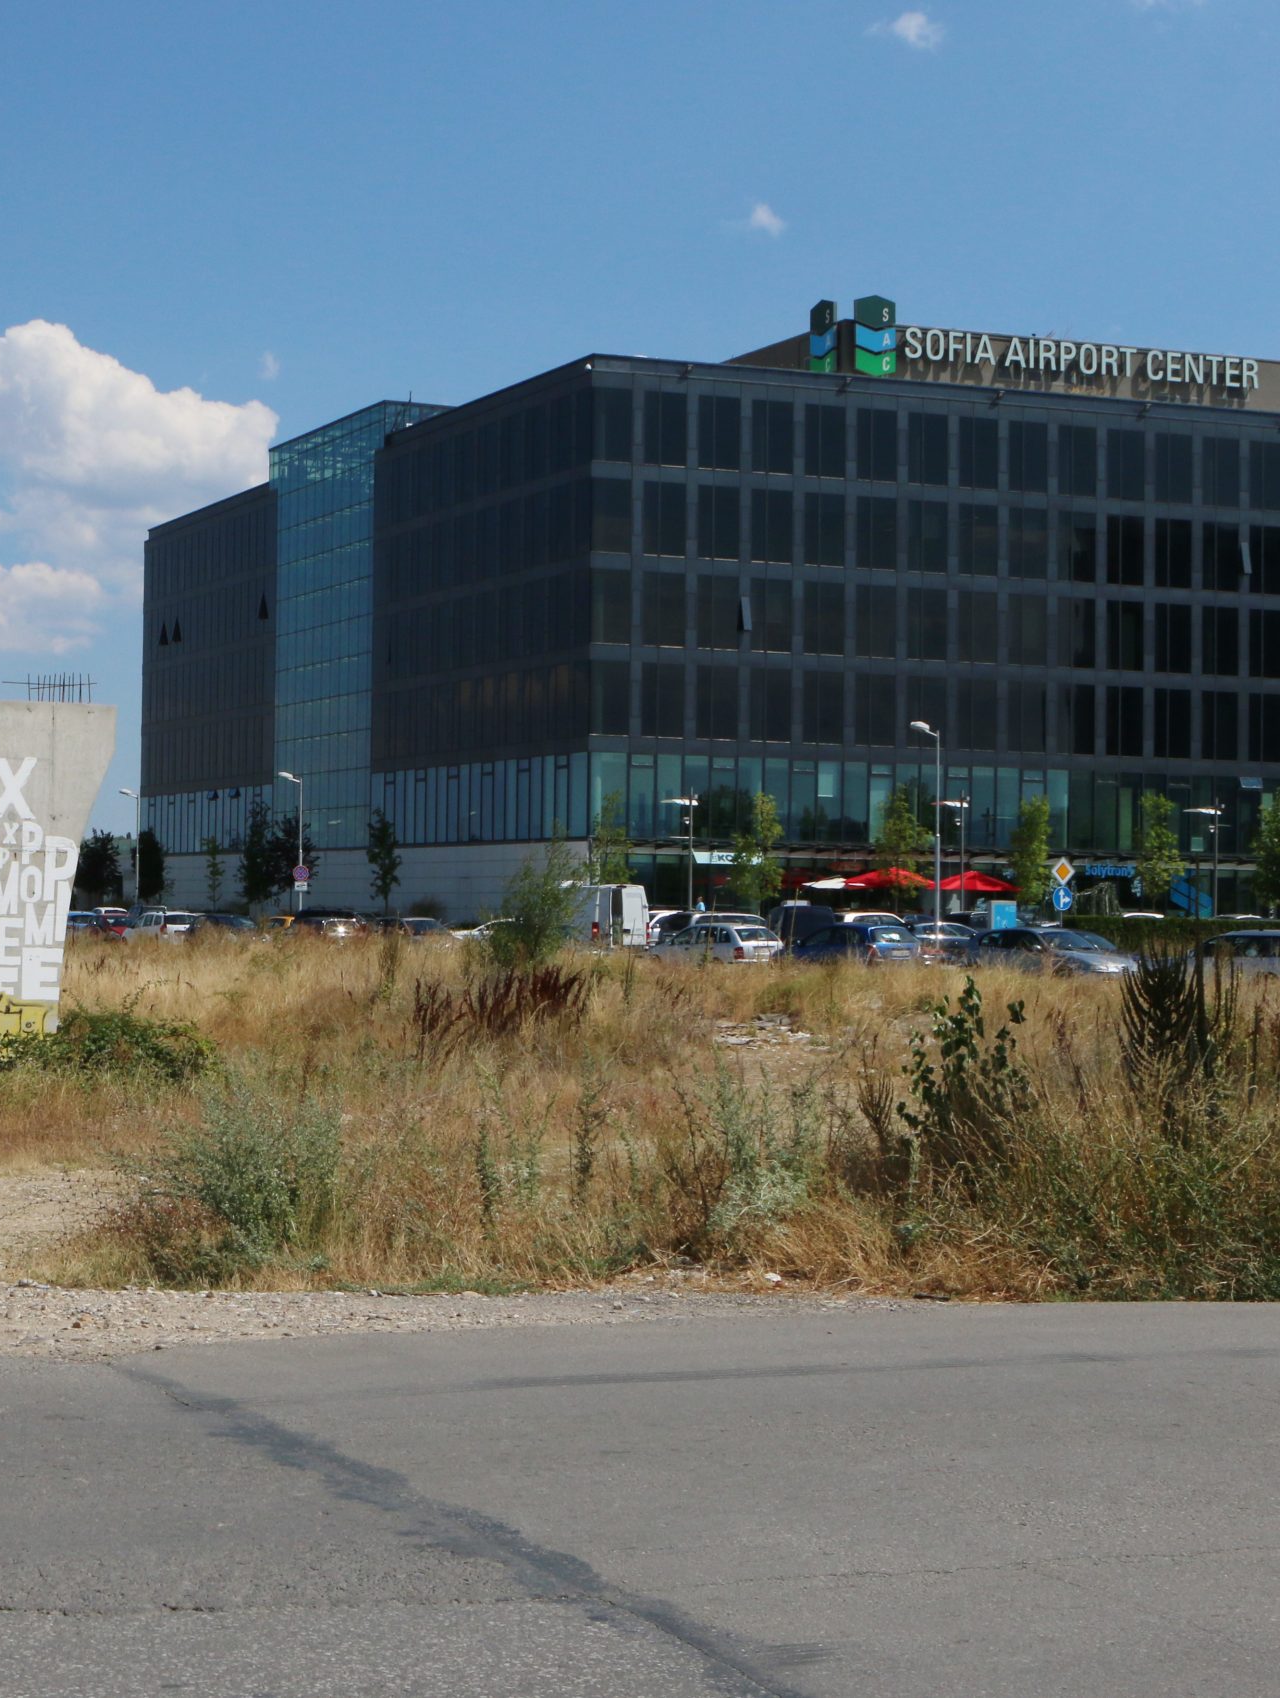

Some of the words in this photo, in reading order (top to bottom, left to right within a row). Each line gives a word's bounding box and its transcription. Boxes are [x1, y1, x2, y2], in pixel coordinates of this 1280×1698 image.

[904, 327, 996, 366] SOFIA
[1004, 337, 1137, 378] AIRPORT
[1147, 350, 1258, 389] CENTER
